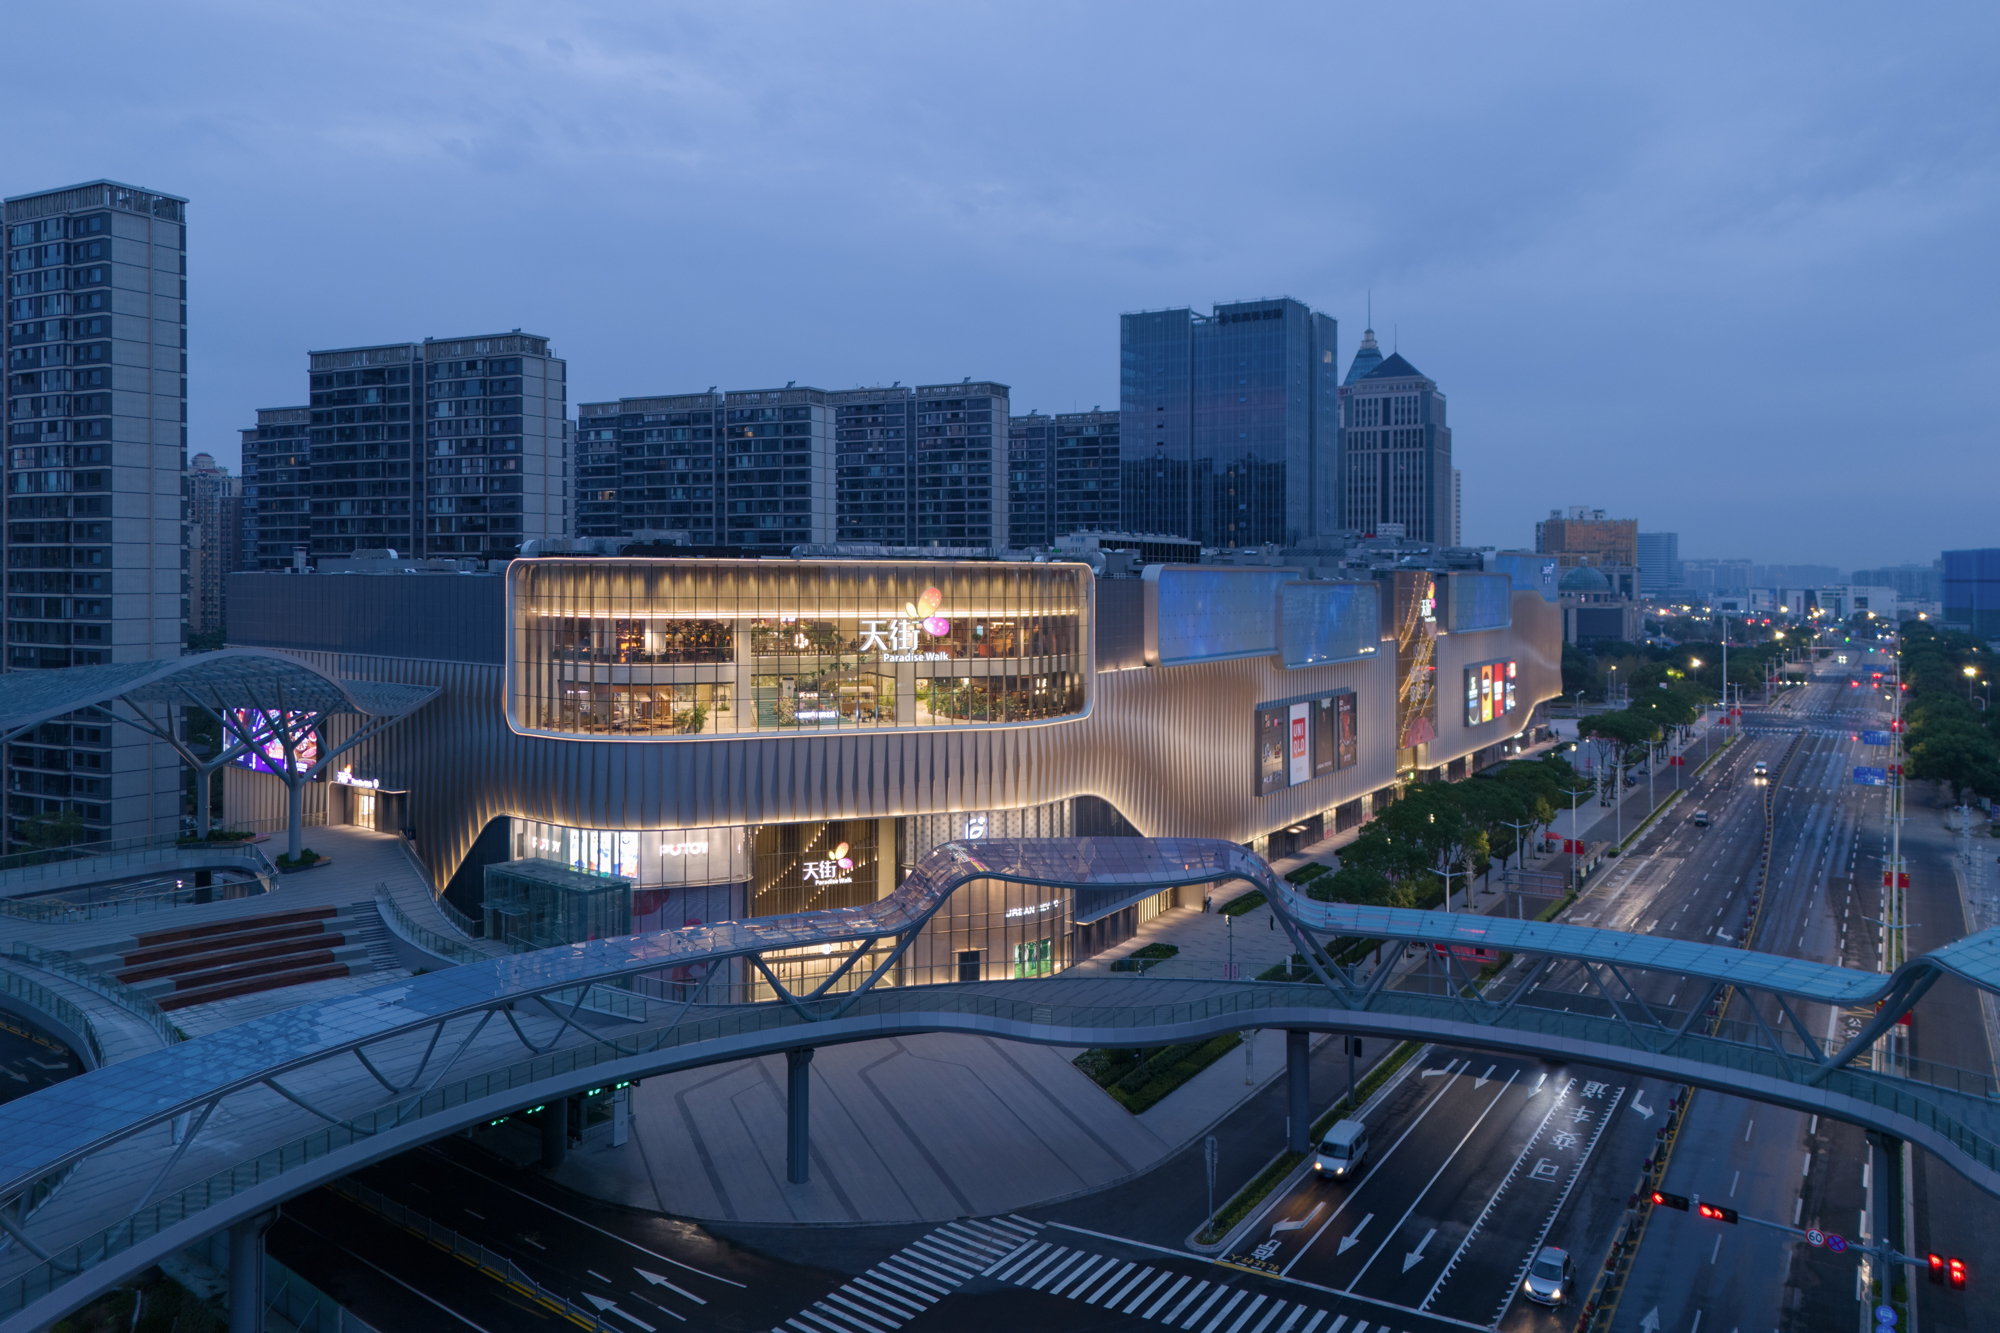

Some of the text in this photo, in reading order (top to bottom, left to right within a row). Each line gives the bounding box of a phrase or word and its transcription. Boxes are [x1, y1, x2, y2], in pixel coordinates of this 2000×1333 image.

[859, 619, 921, 651] 天街
[883, 651, 949, 662] Paradise Walk
[1293, 722, 1304, 737] UNI
[1293, 738, 1305, 756] QLO
[803, 860, 837, 880] 天街
[1809, 1231, 1822, 1243] 60
